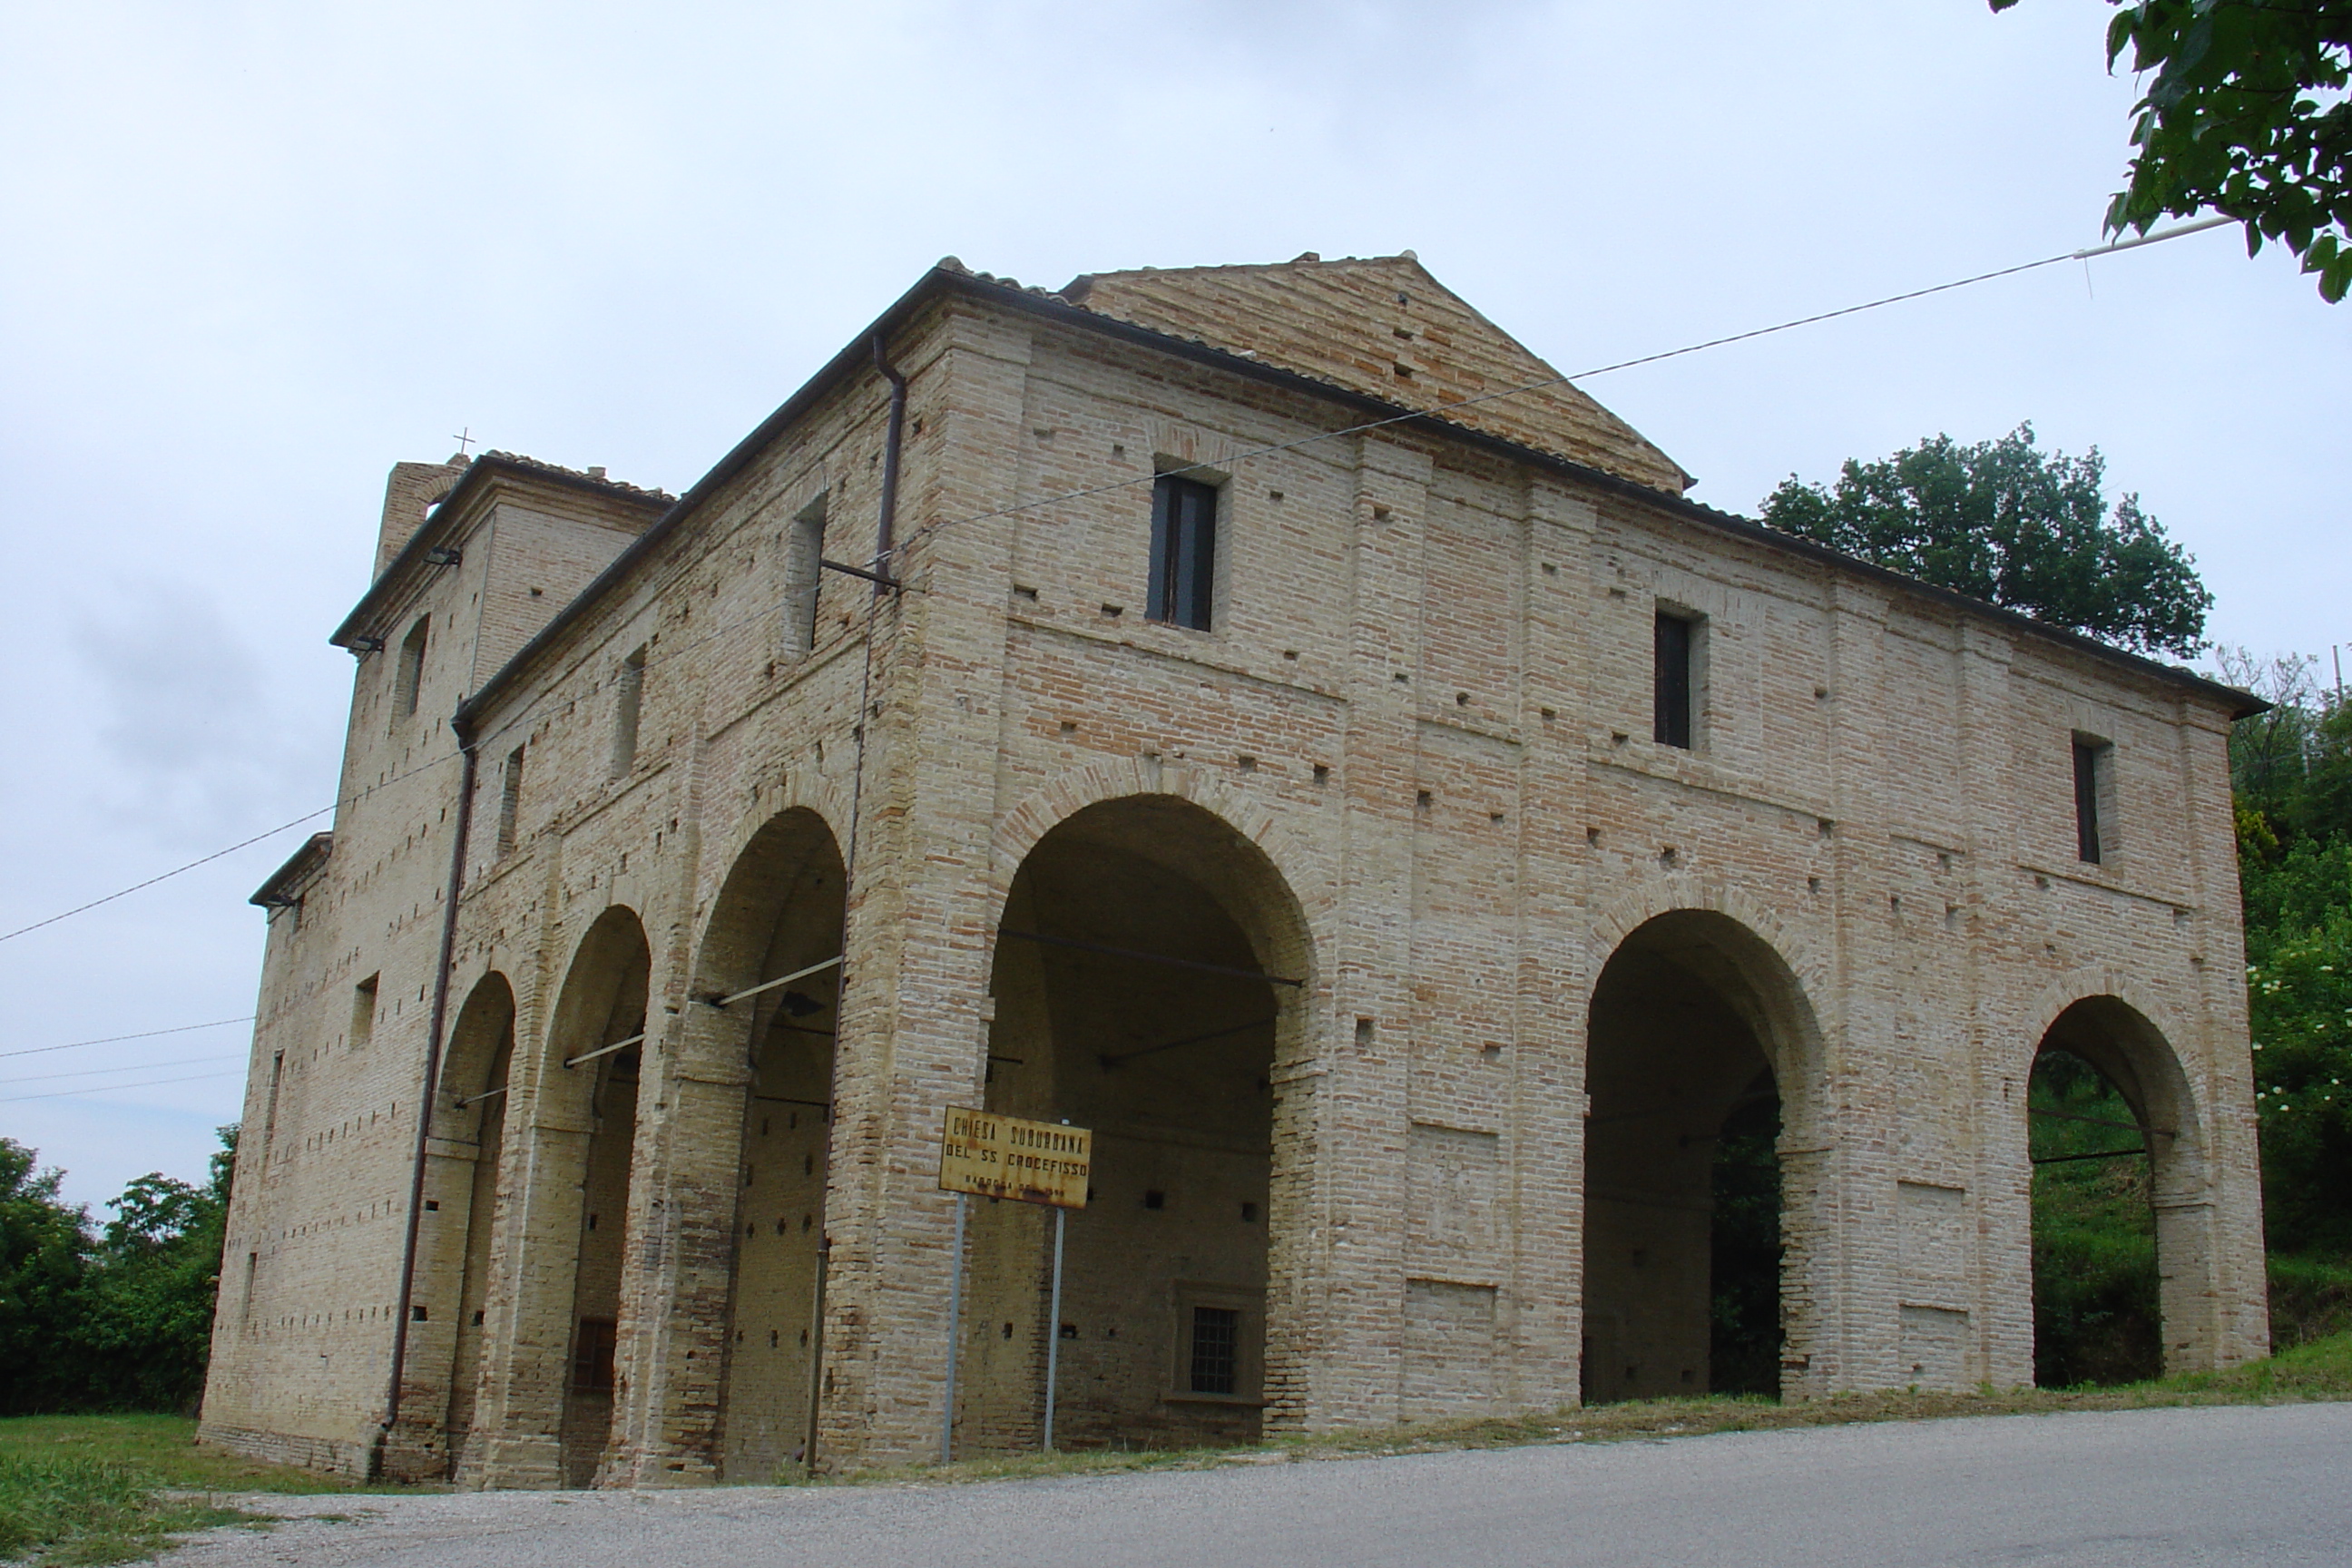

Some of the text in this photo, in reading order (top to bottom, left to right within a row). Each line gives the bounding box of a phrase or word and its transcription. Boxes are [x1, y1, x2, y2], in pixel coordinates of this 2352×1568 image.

[954, 1117, 1083, 1154] CHIESA SUBURBANA
[946, 1143, 1087, 1176] DEL SS CROCEFISSO
